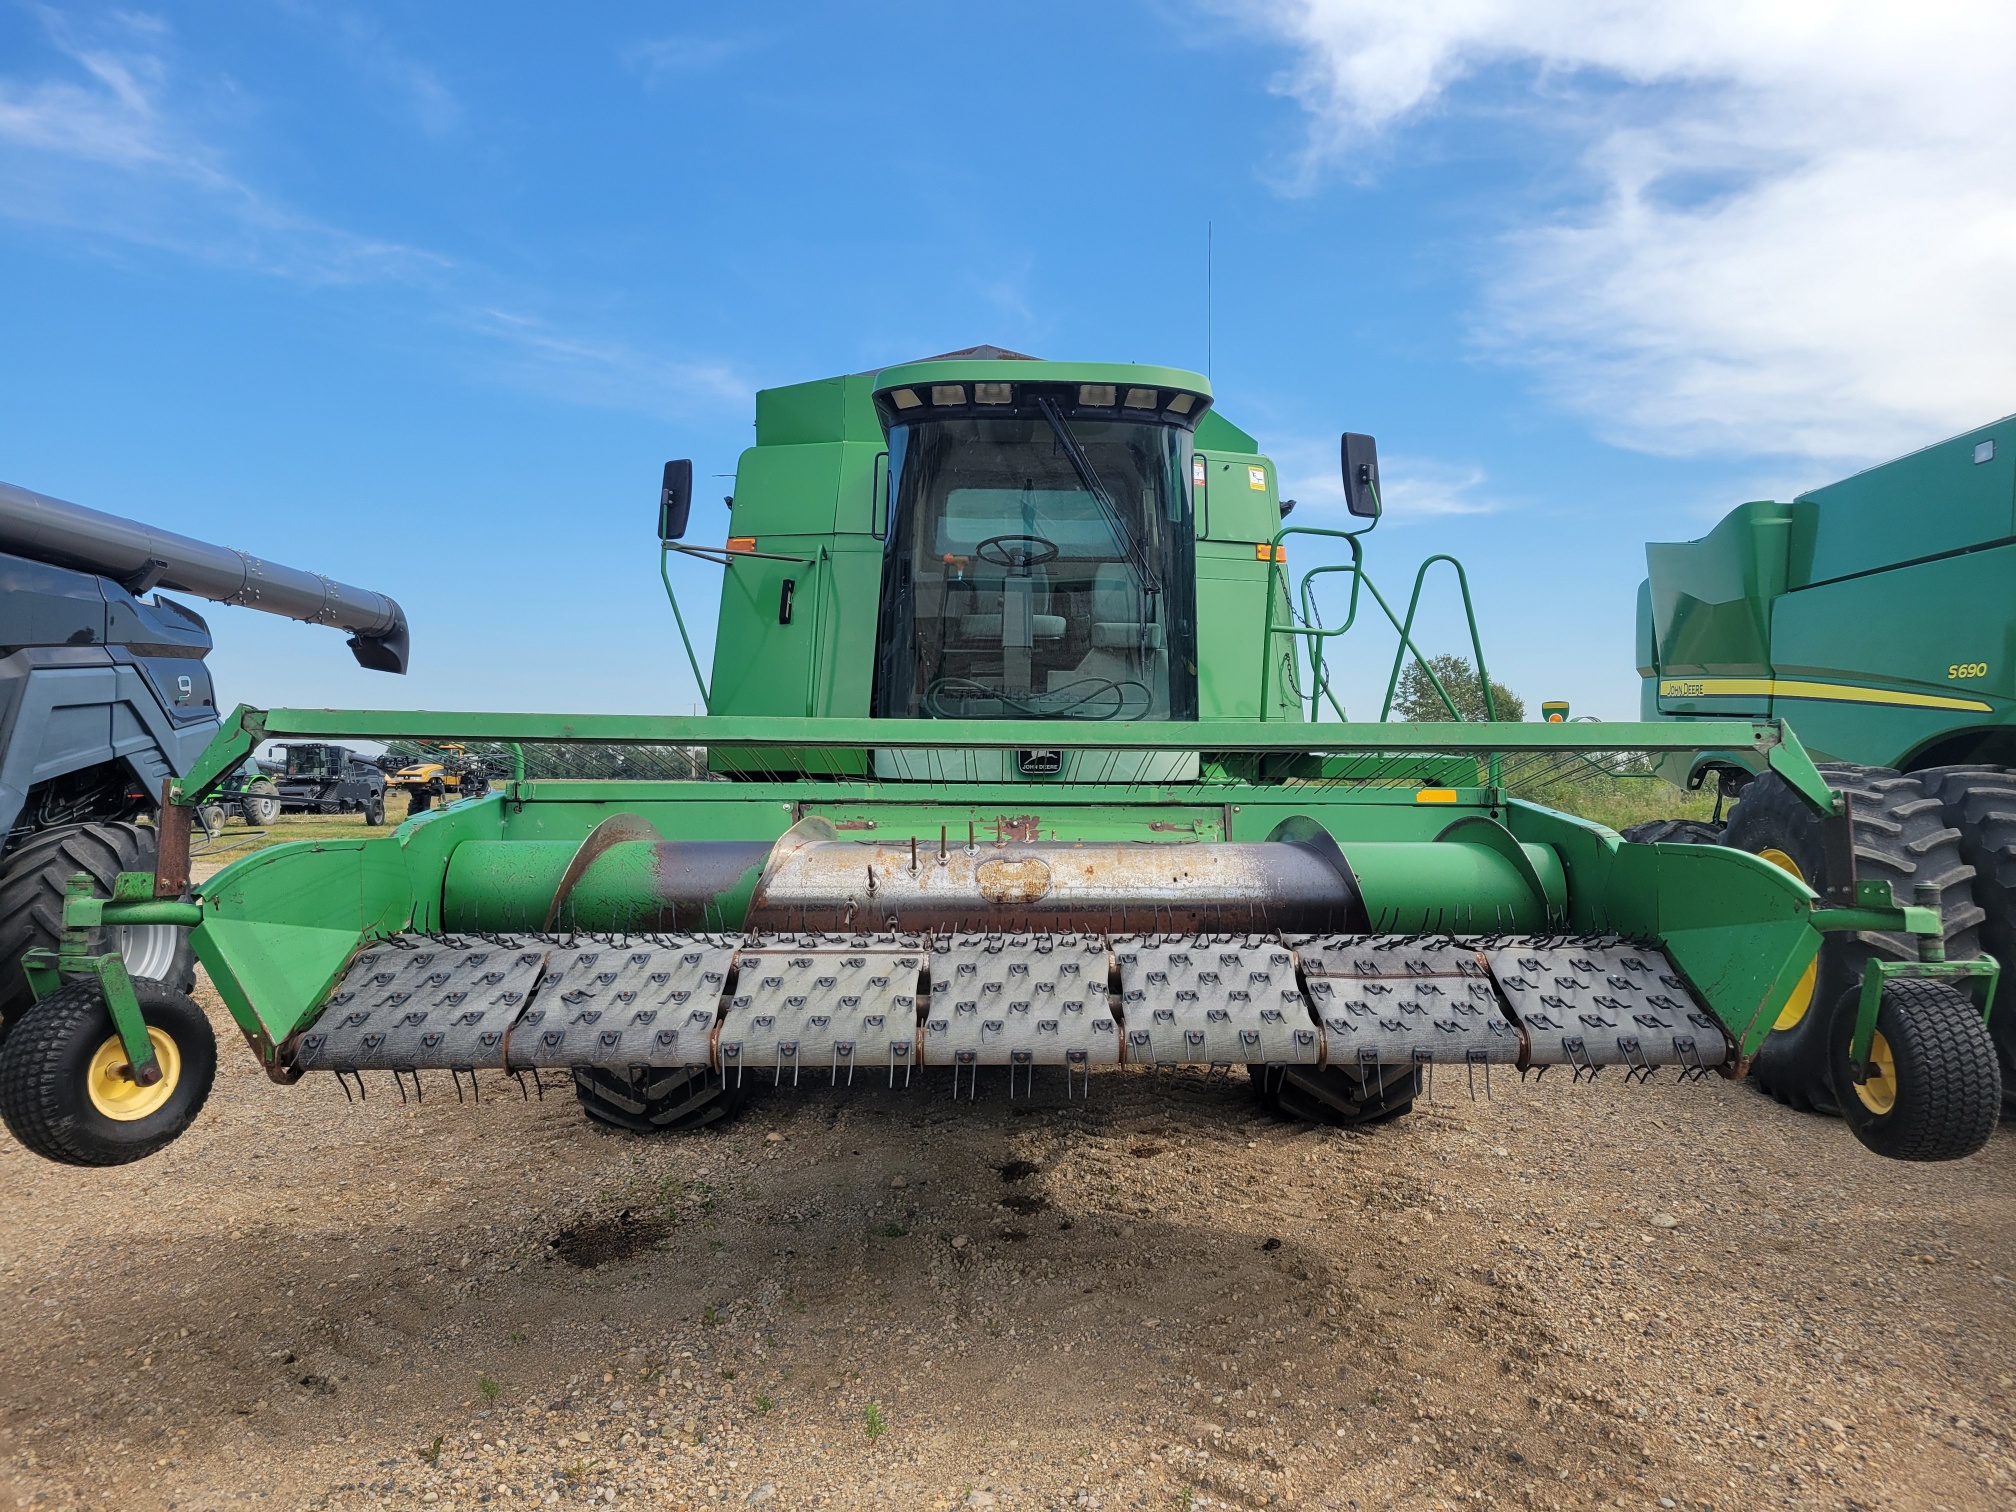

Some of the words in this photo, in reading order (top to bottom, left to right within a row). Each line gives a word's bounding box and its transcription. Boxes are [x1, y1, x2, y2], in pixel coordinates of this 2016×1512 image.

[1947, 662, 1988, 679] S690
[178, 675, 192, 701] 9
[1667, 683, 1683, 696] JOHN
[1683, 682, 1704, 696] DEERE
